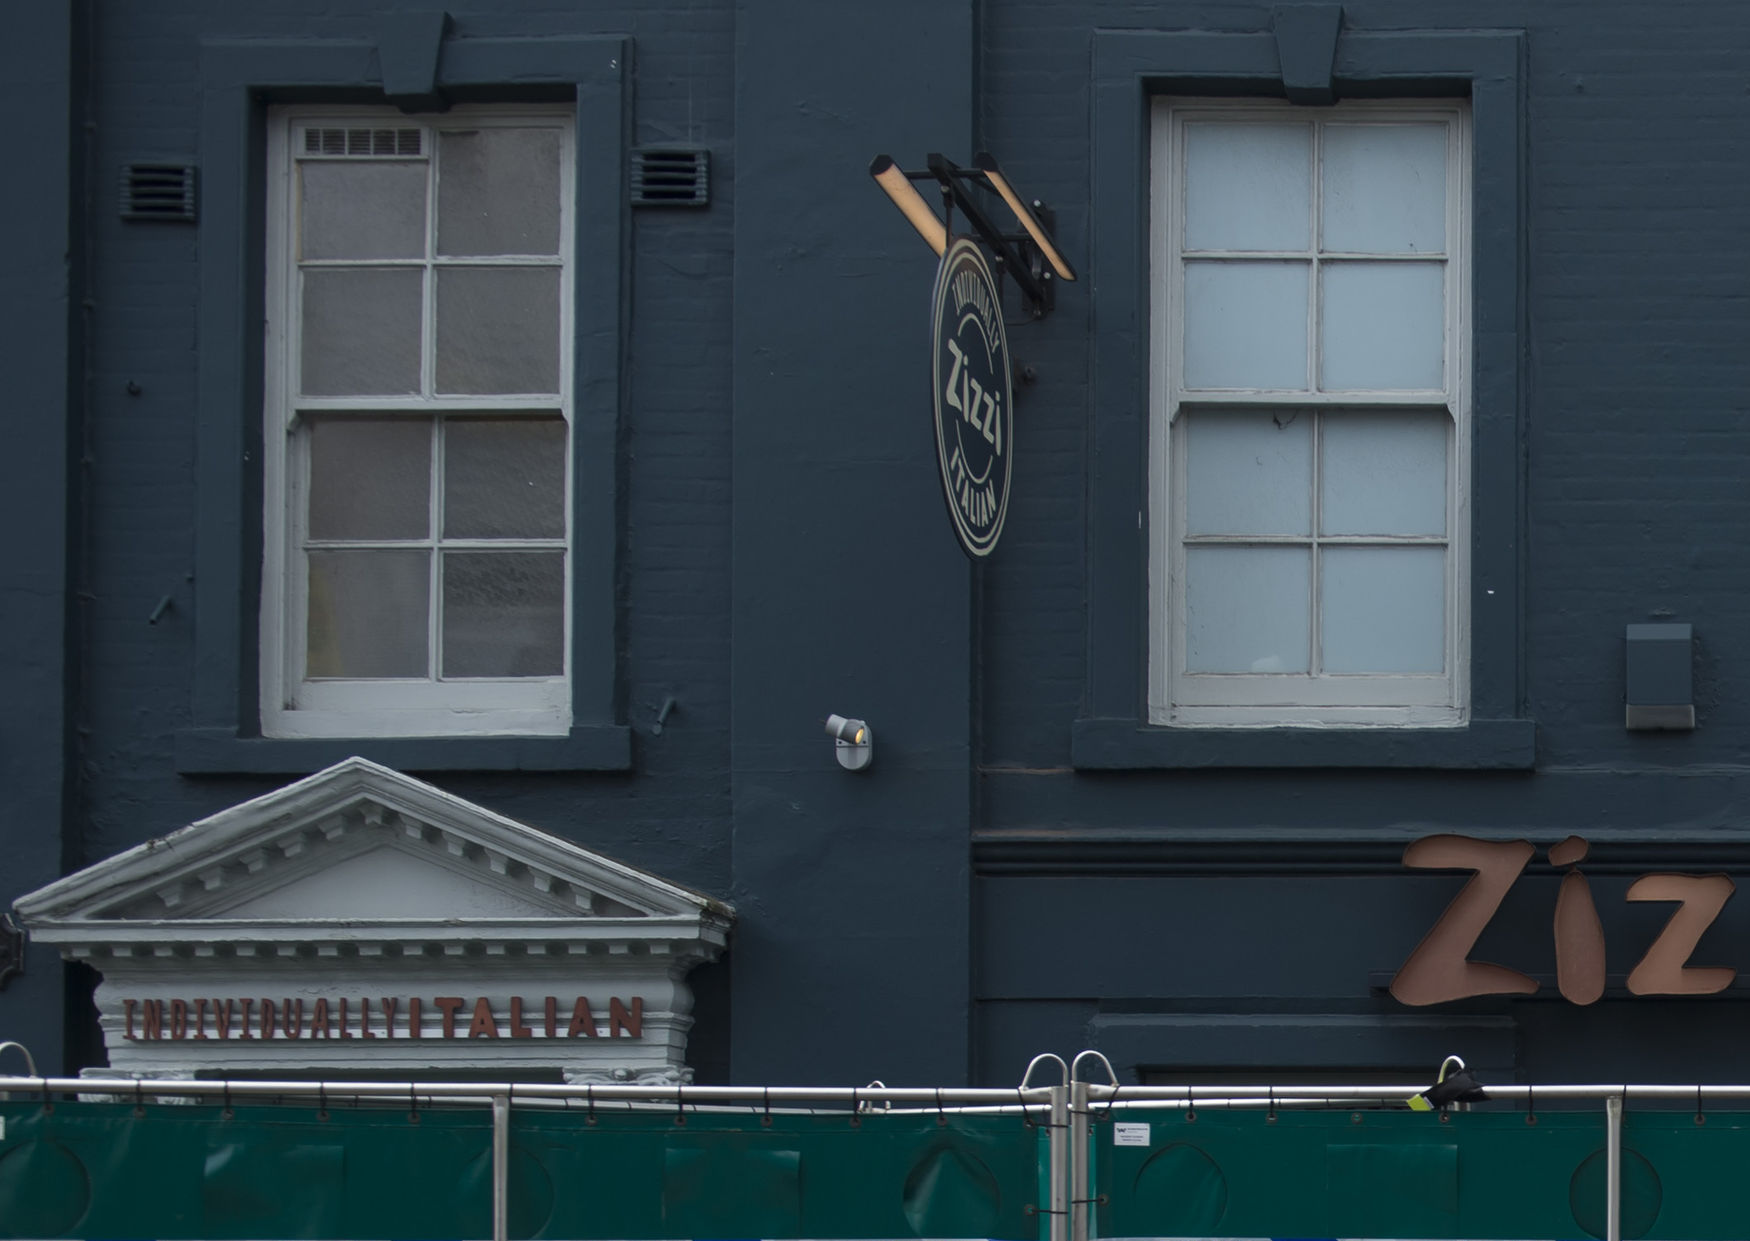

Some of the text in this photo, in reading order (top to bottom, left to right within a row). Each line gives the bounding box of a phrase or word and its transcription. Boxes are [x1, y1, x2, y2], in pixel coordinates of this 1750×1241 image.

[946, 338, 1001, 456] Zizzi
[950, 446, 997, 528] ITALIAN
[122, 996, 644, 1040] INDIVIDUALLY ITALIAN
